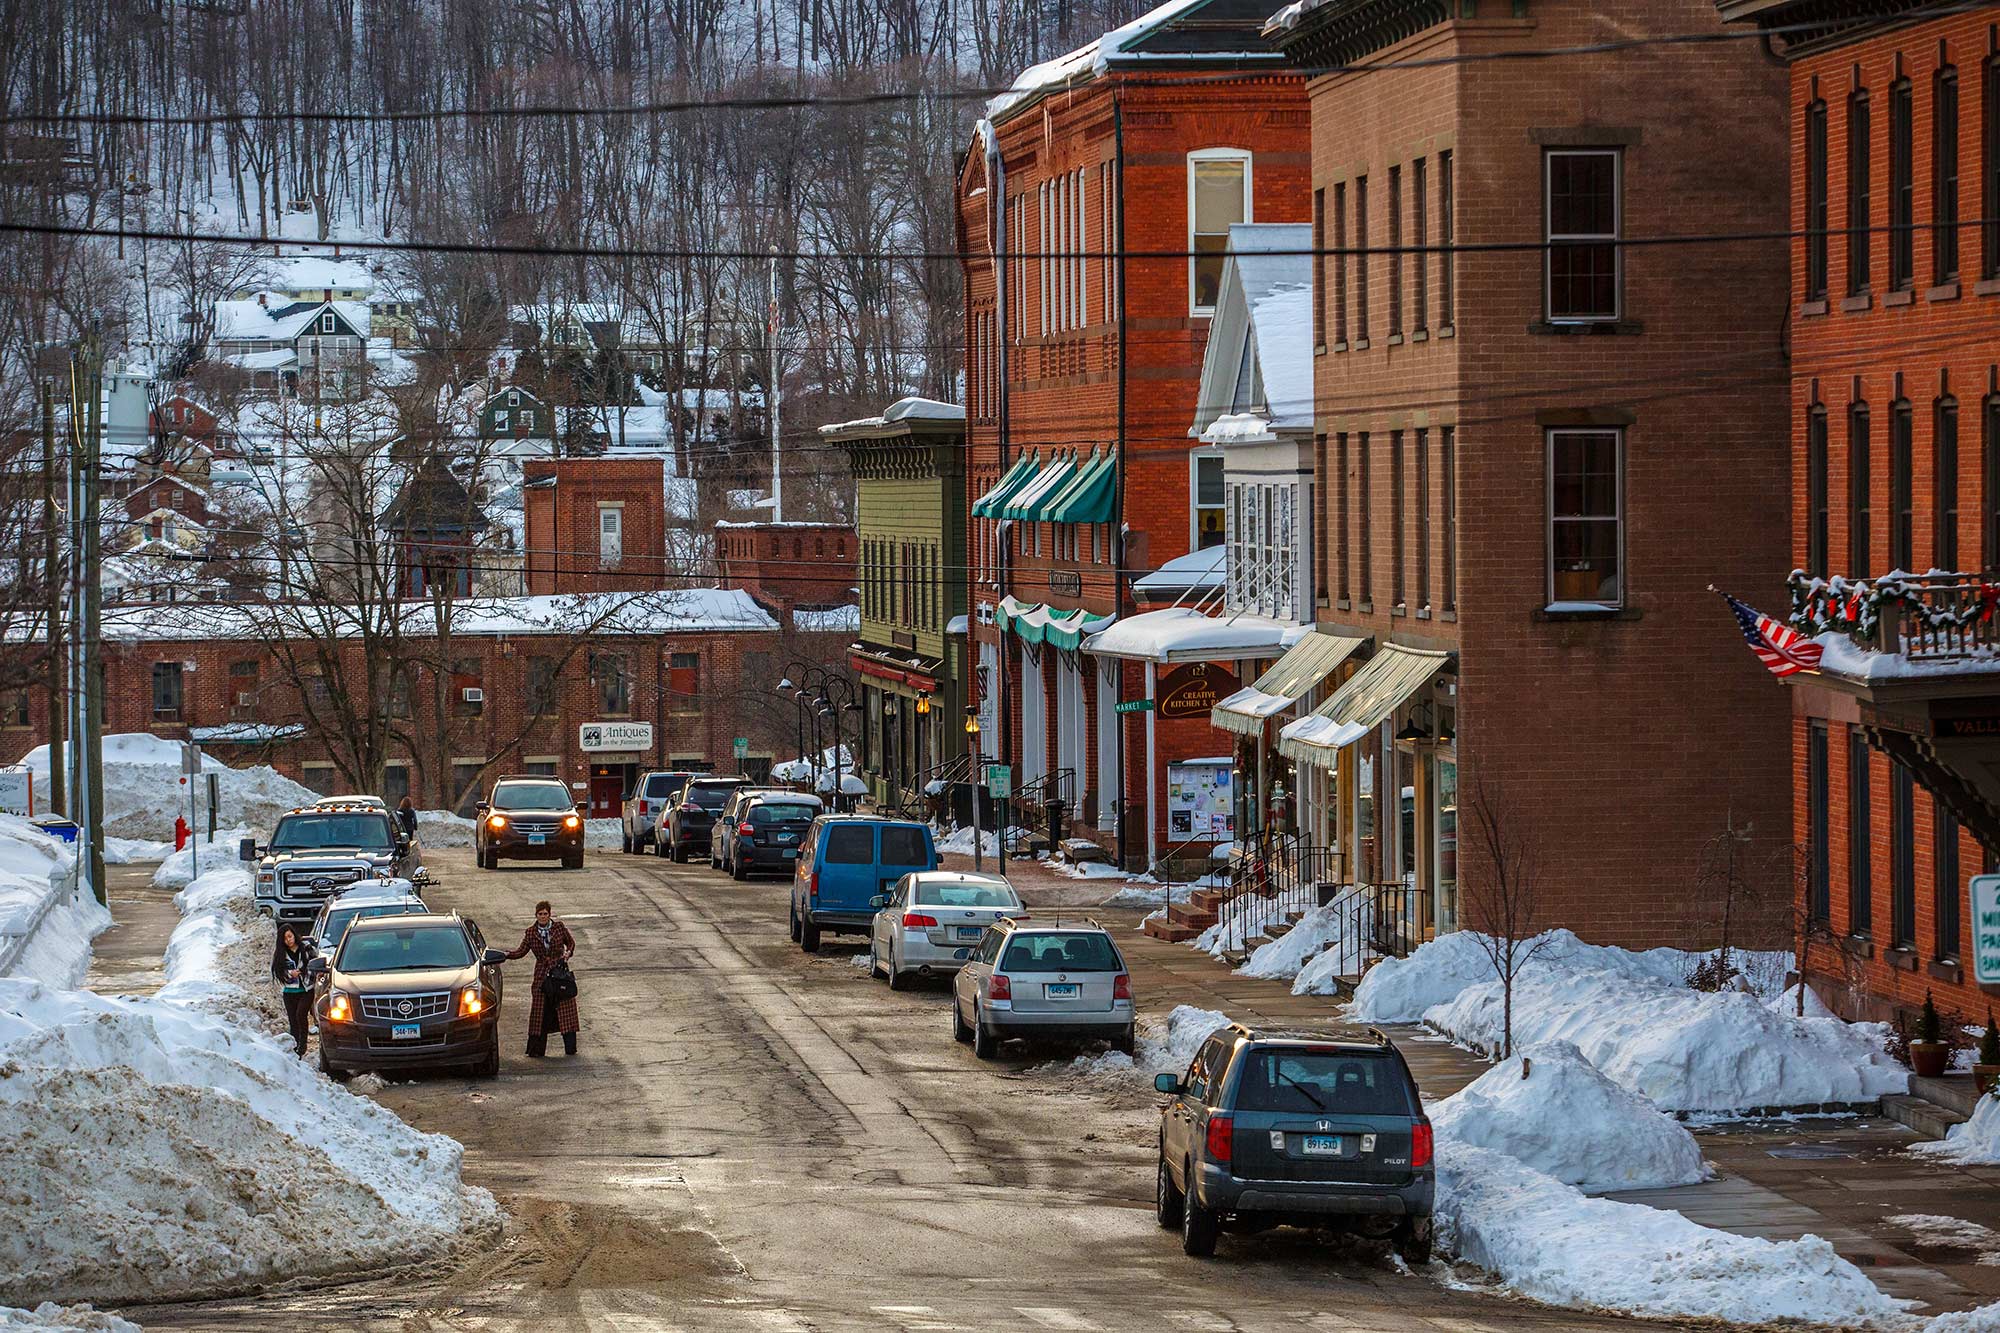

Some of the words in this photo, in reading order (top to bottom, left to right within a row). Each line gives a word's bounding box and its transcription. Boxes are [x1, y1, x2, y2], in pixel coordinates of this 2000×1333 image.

[1183, 690, 1216, 699] CREATIVE
[1116, 702, 1140, 712] MARKET
[1170, 700, 1200, 708] KITCHEN
[1202, 699, 1209, 707] &
[603, 725, 649, 739] Antiques
[619, 739, 650, 747] Farmington
